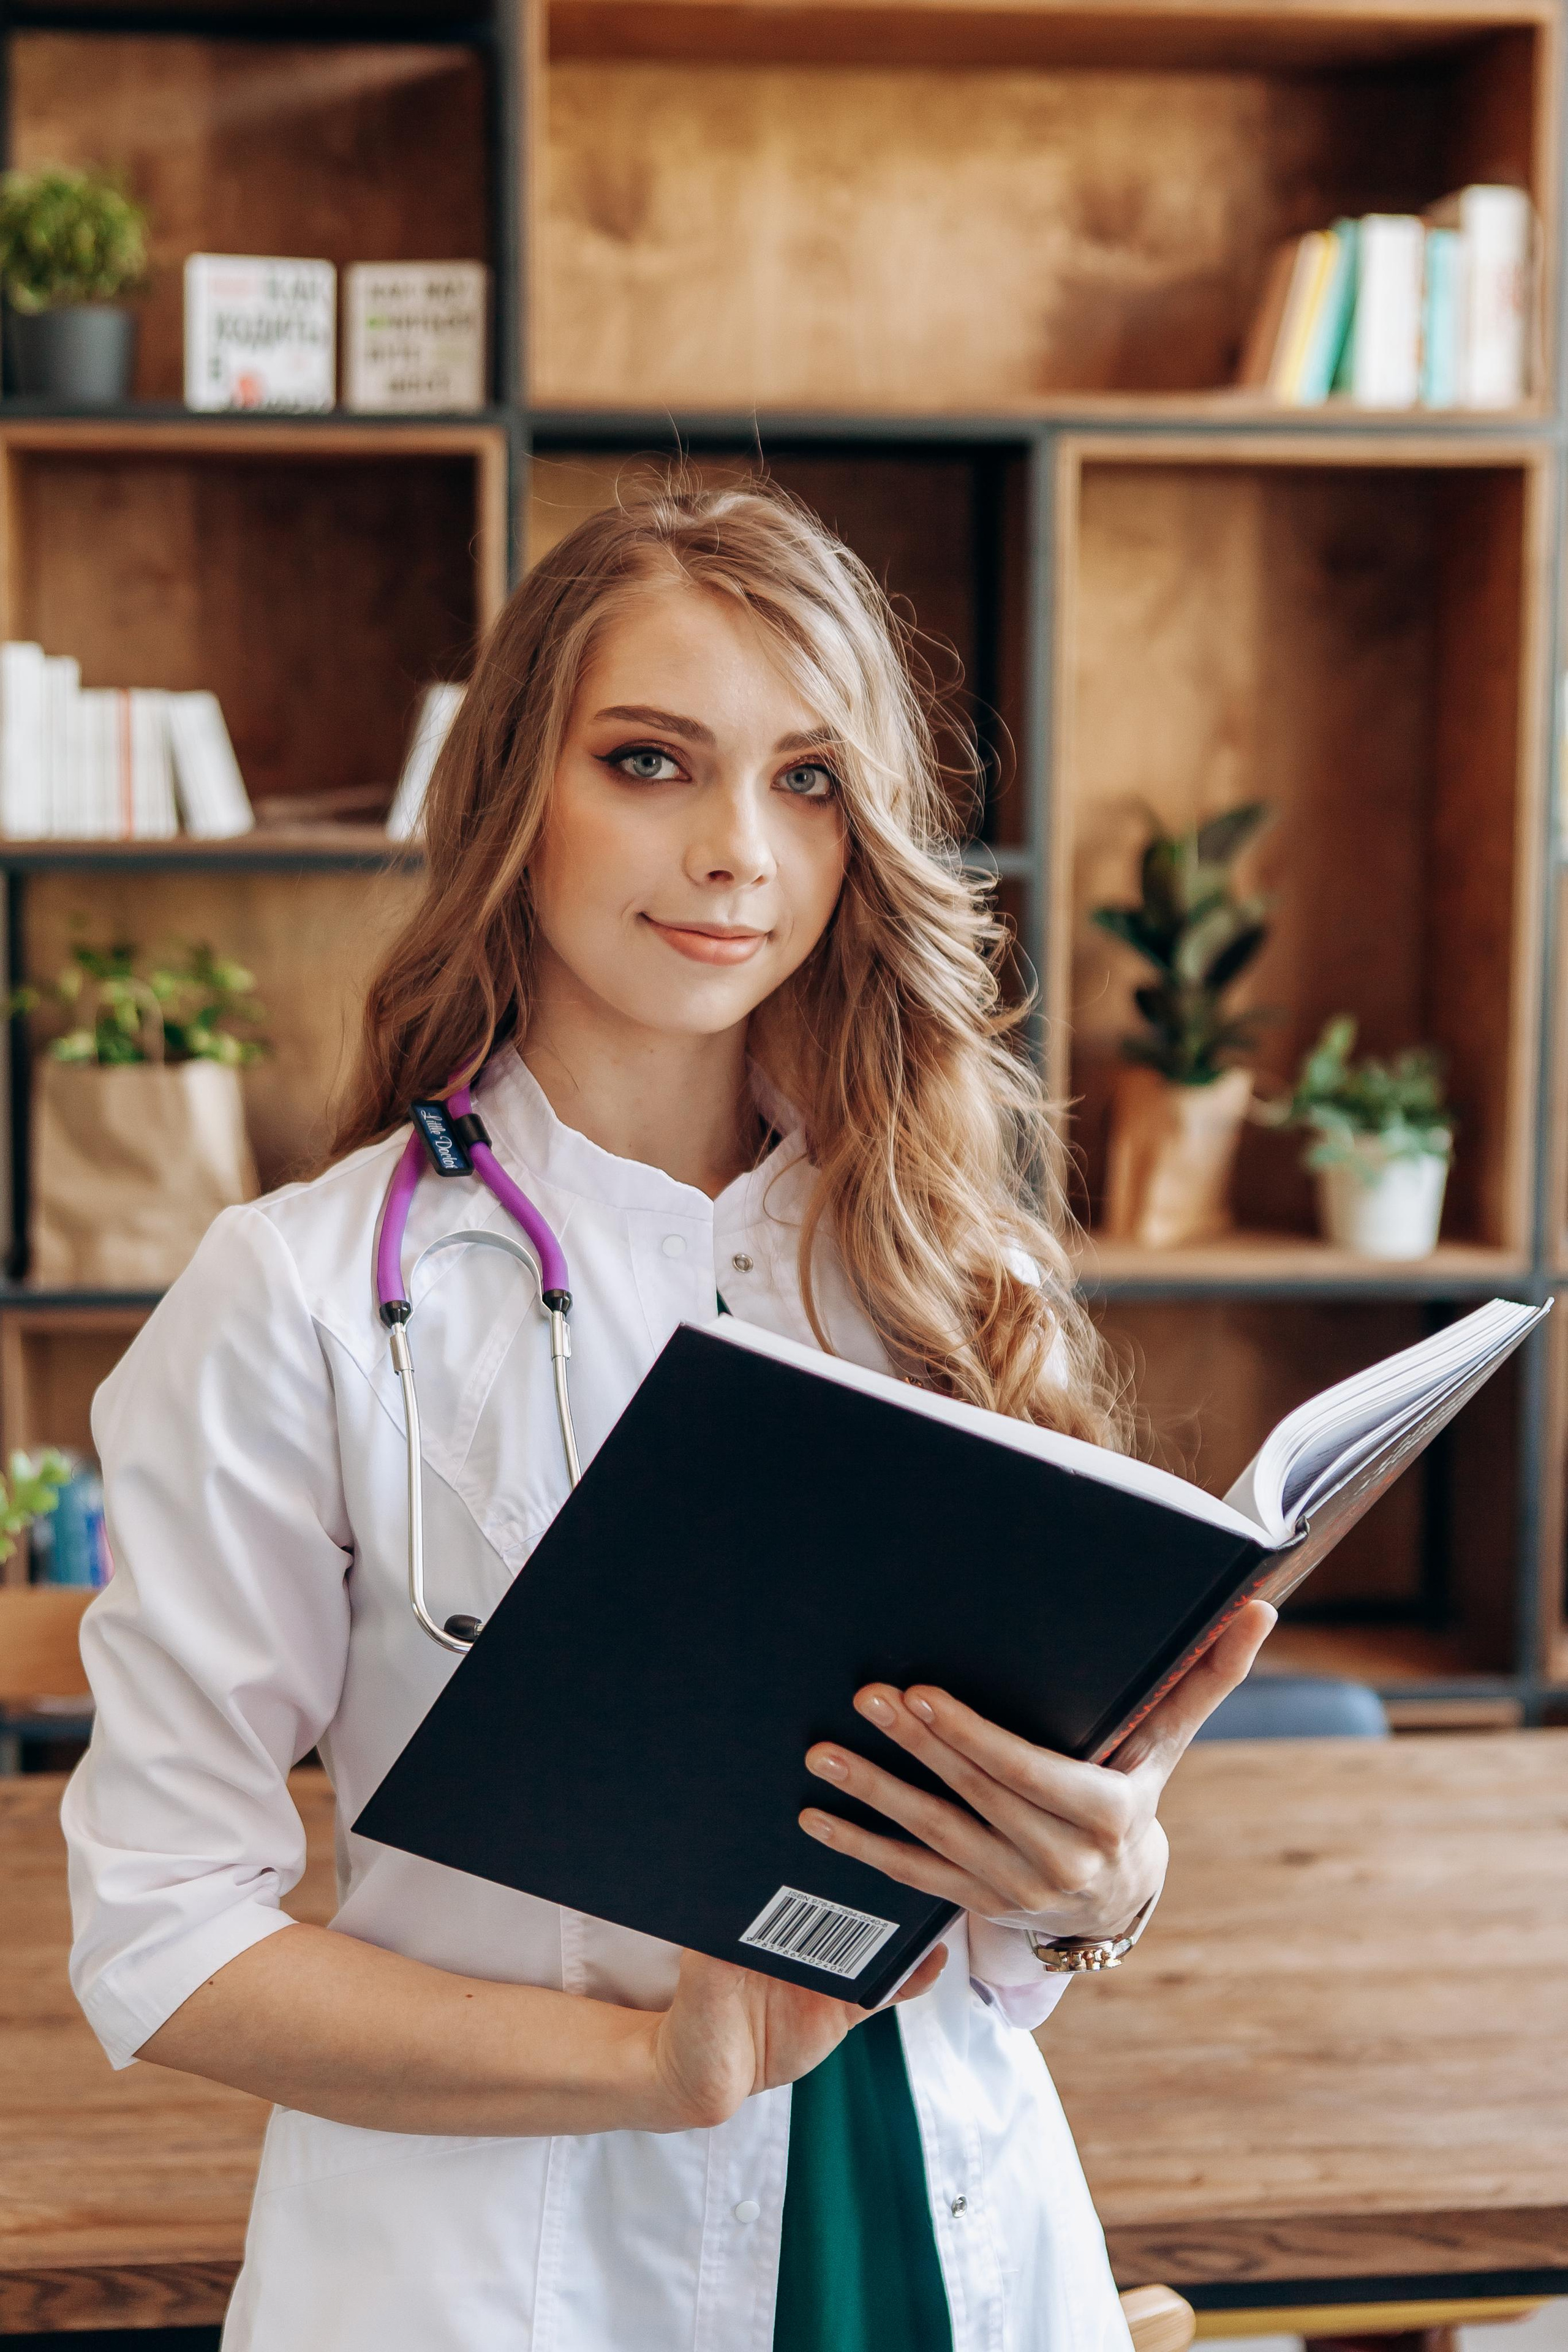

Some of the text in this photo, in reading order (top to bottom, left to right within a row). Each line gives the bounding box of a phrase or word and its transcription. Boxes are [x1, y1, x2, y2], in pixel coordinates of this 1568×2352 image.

[421, 1110, 458, 1169] Little Doctor
[787, 1890, 811, 1902] ISBN
